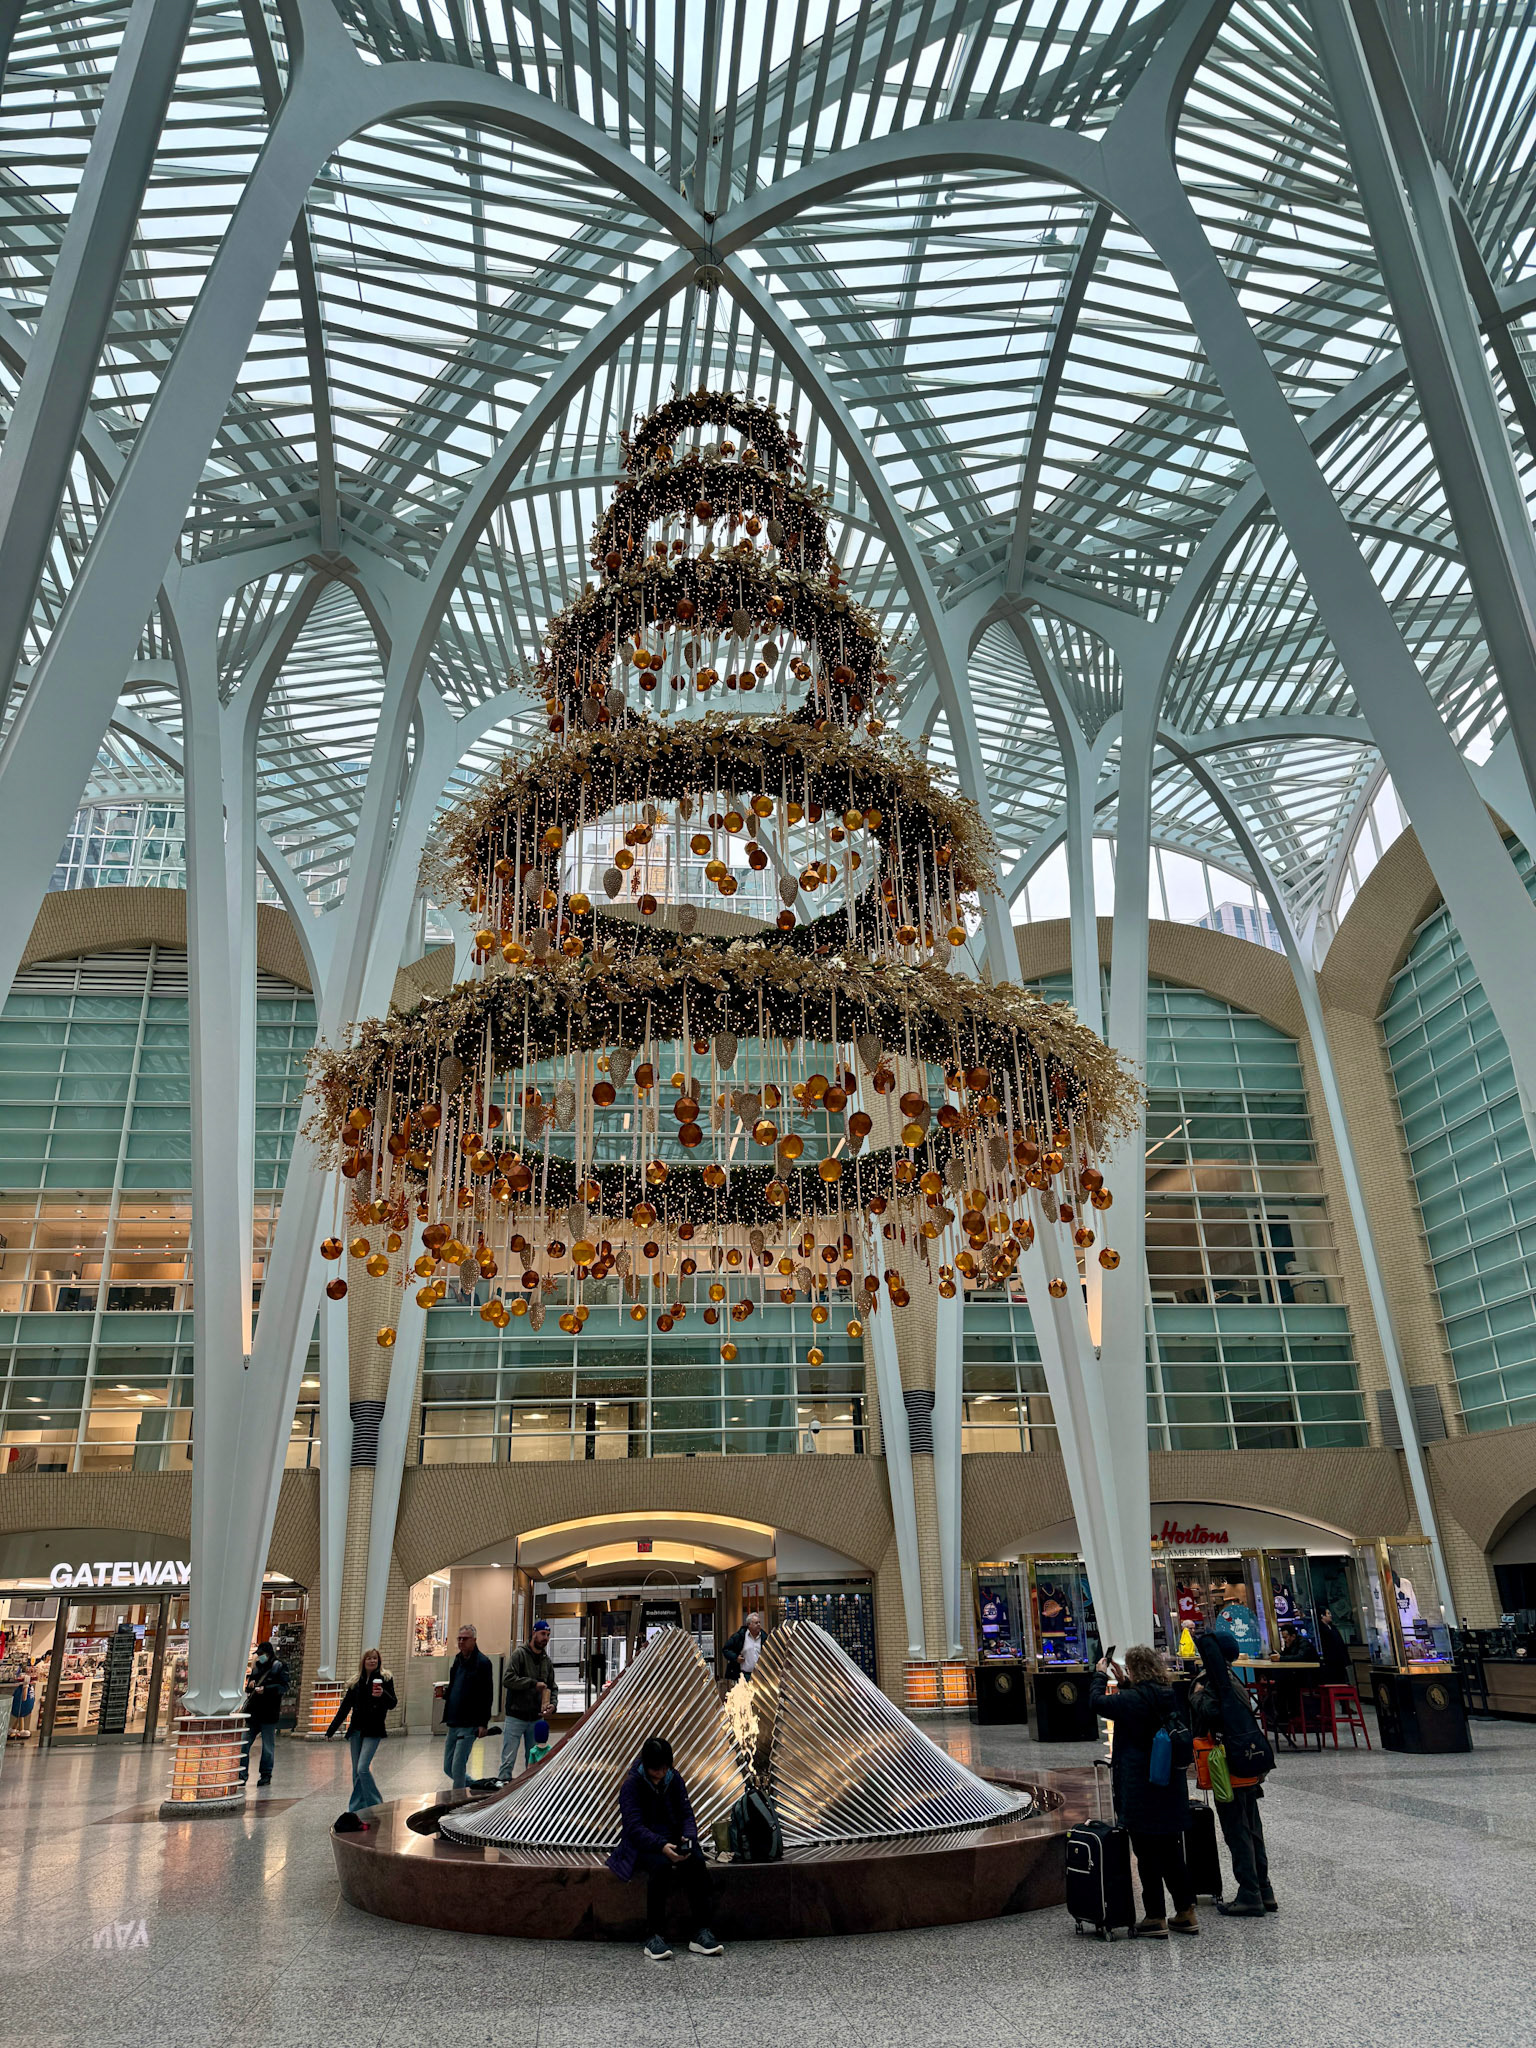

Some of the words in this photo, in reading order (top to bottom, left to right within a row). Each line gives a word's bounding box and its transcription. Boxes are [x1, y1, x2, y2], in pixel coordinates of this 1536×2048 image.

[1161, 1520, 1229, 1544] Hortons
[1189, 1548, 1226, 1557] SPECIAL
[50, 1560, 191, 1588] GATEWAY
